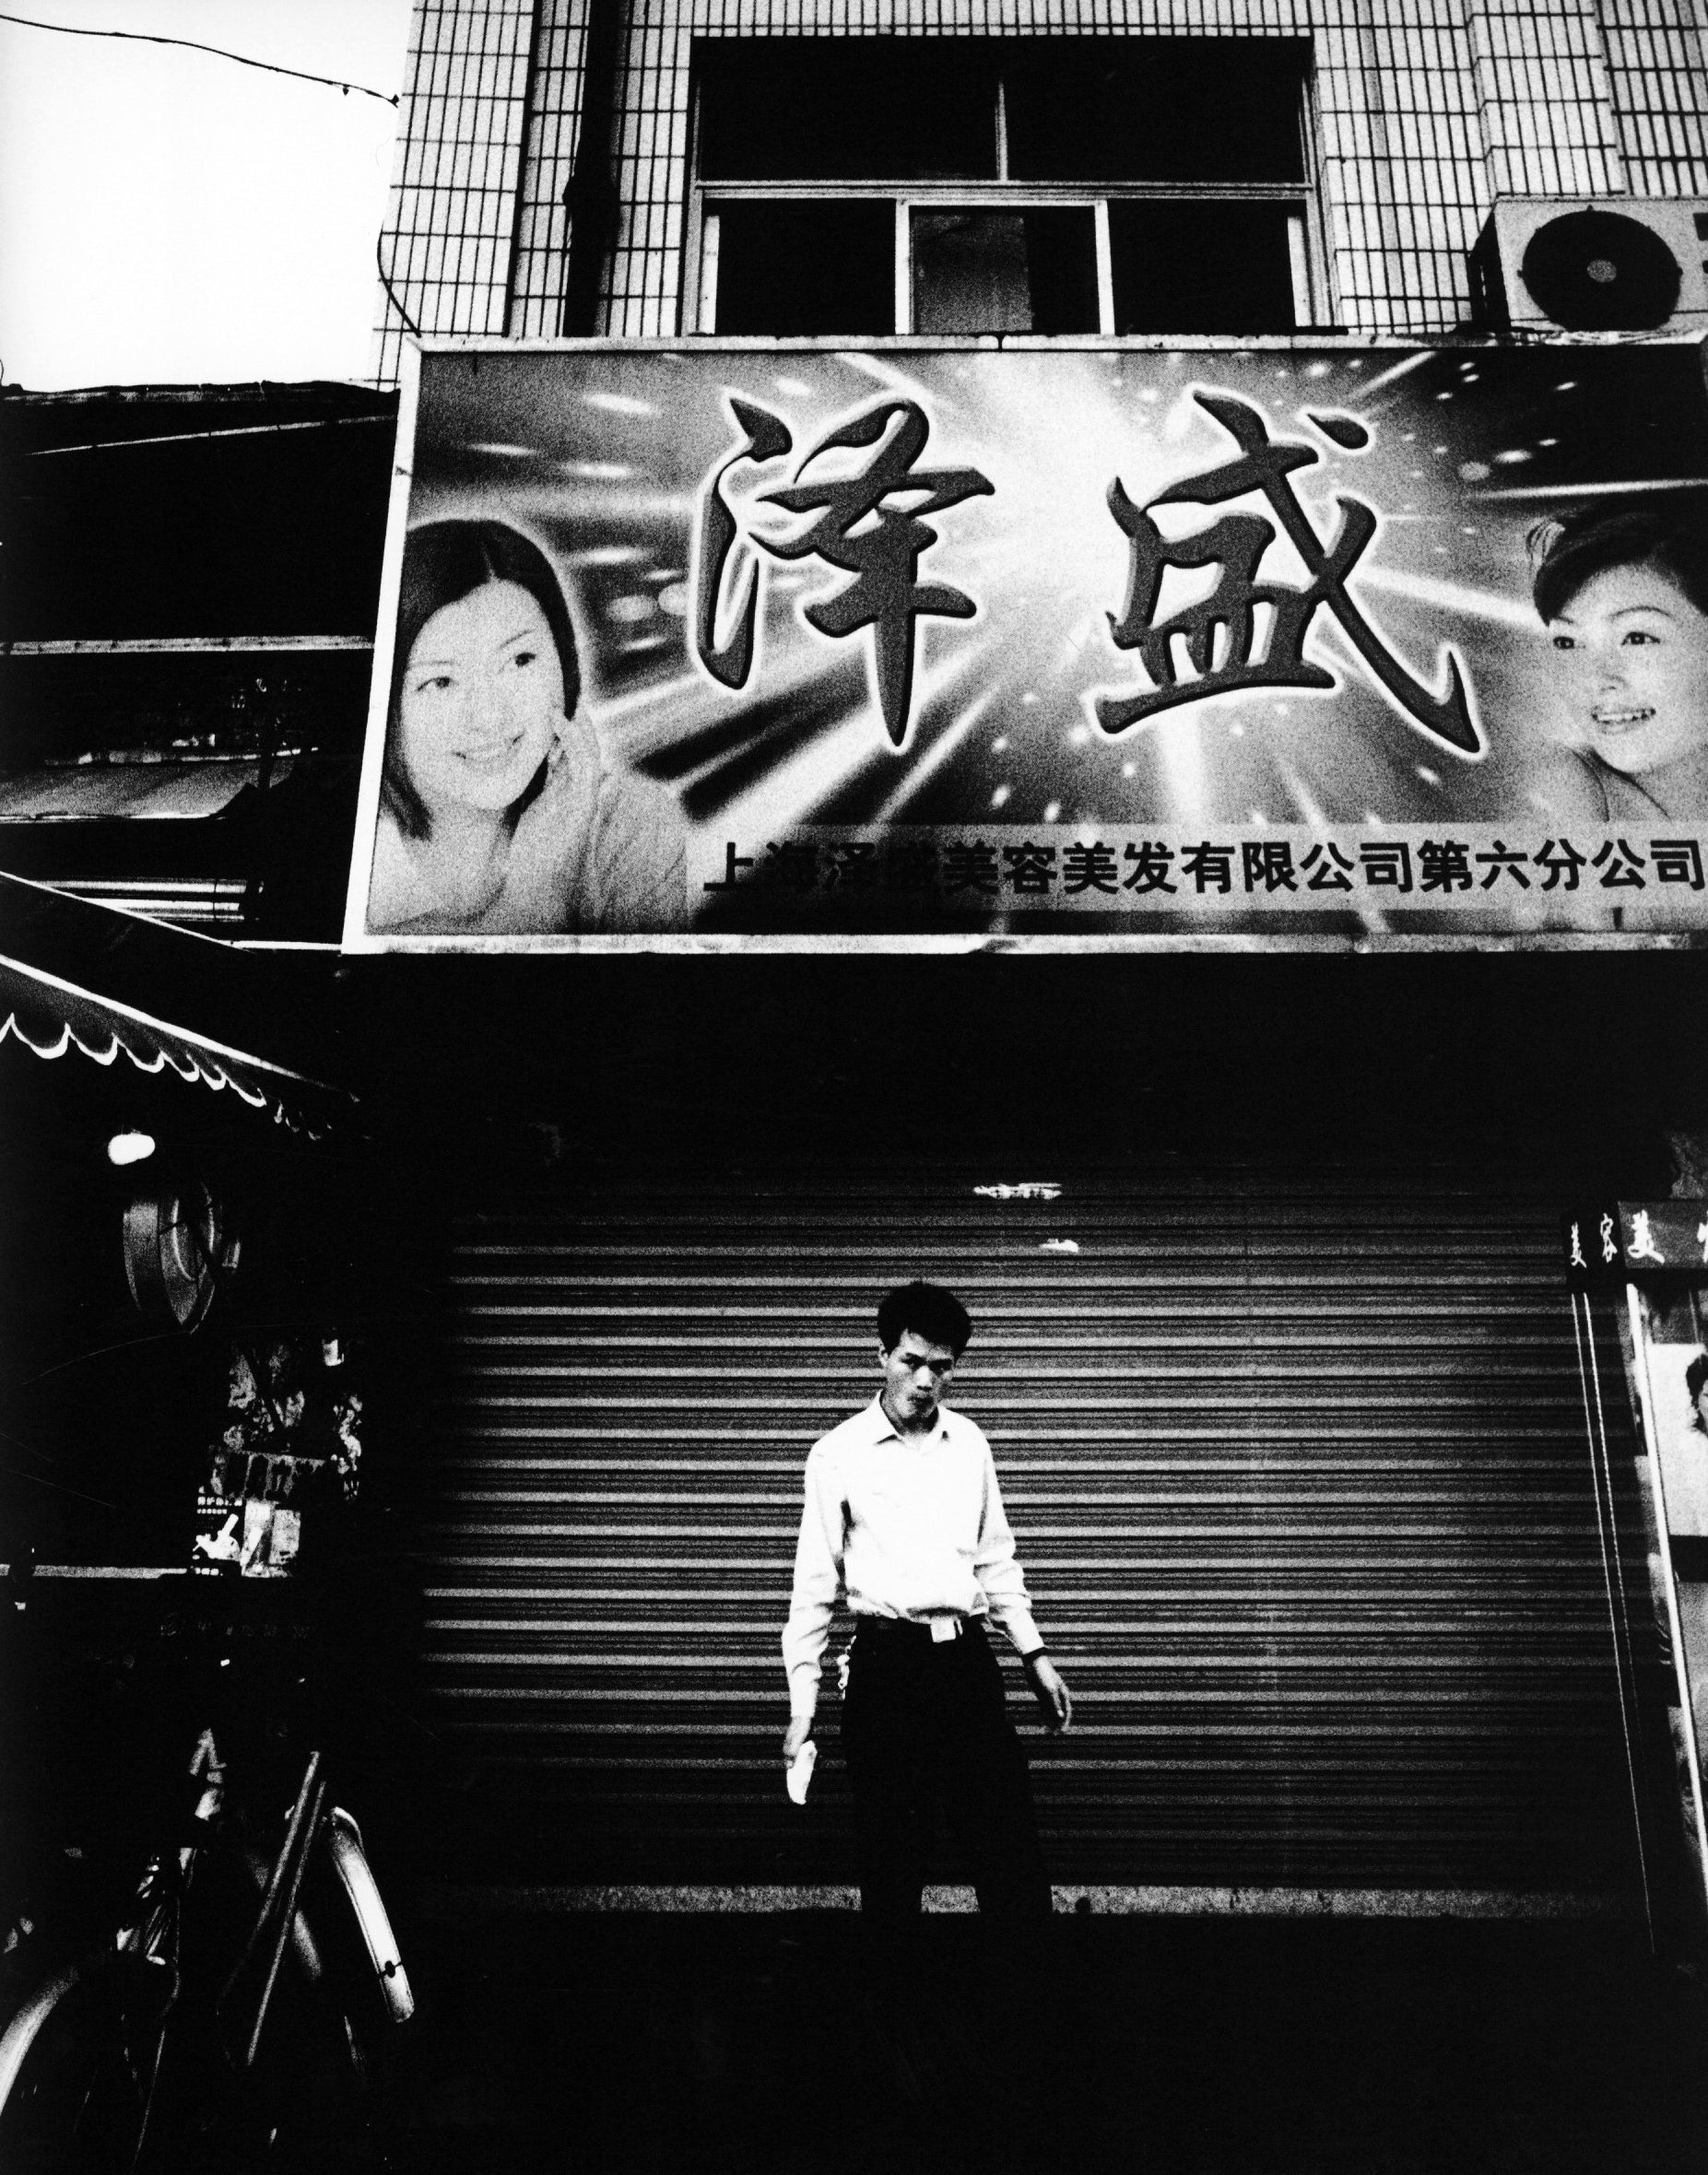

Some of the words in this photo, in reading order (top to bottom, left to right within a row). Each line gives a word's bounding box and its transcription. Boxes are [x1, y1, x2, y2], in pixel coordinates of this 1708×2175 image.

[703, 839, 1705, 894] 上海泽美容美发有限公司第六分公司
